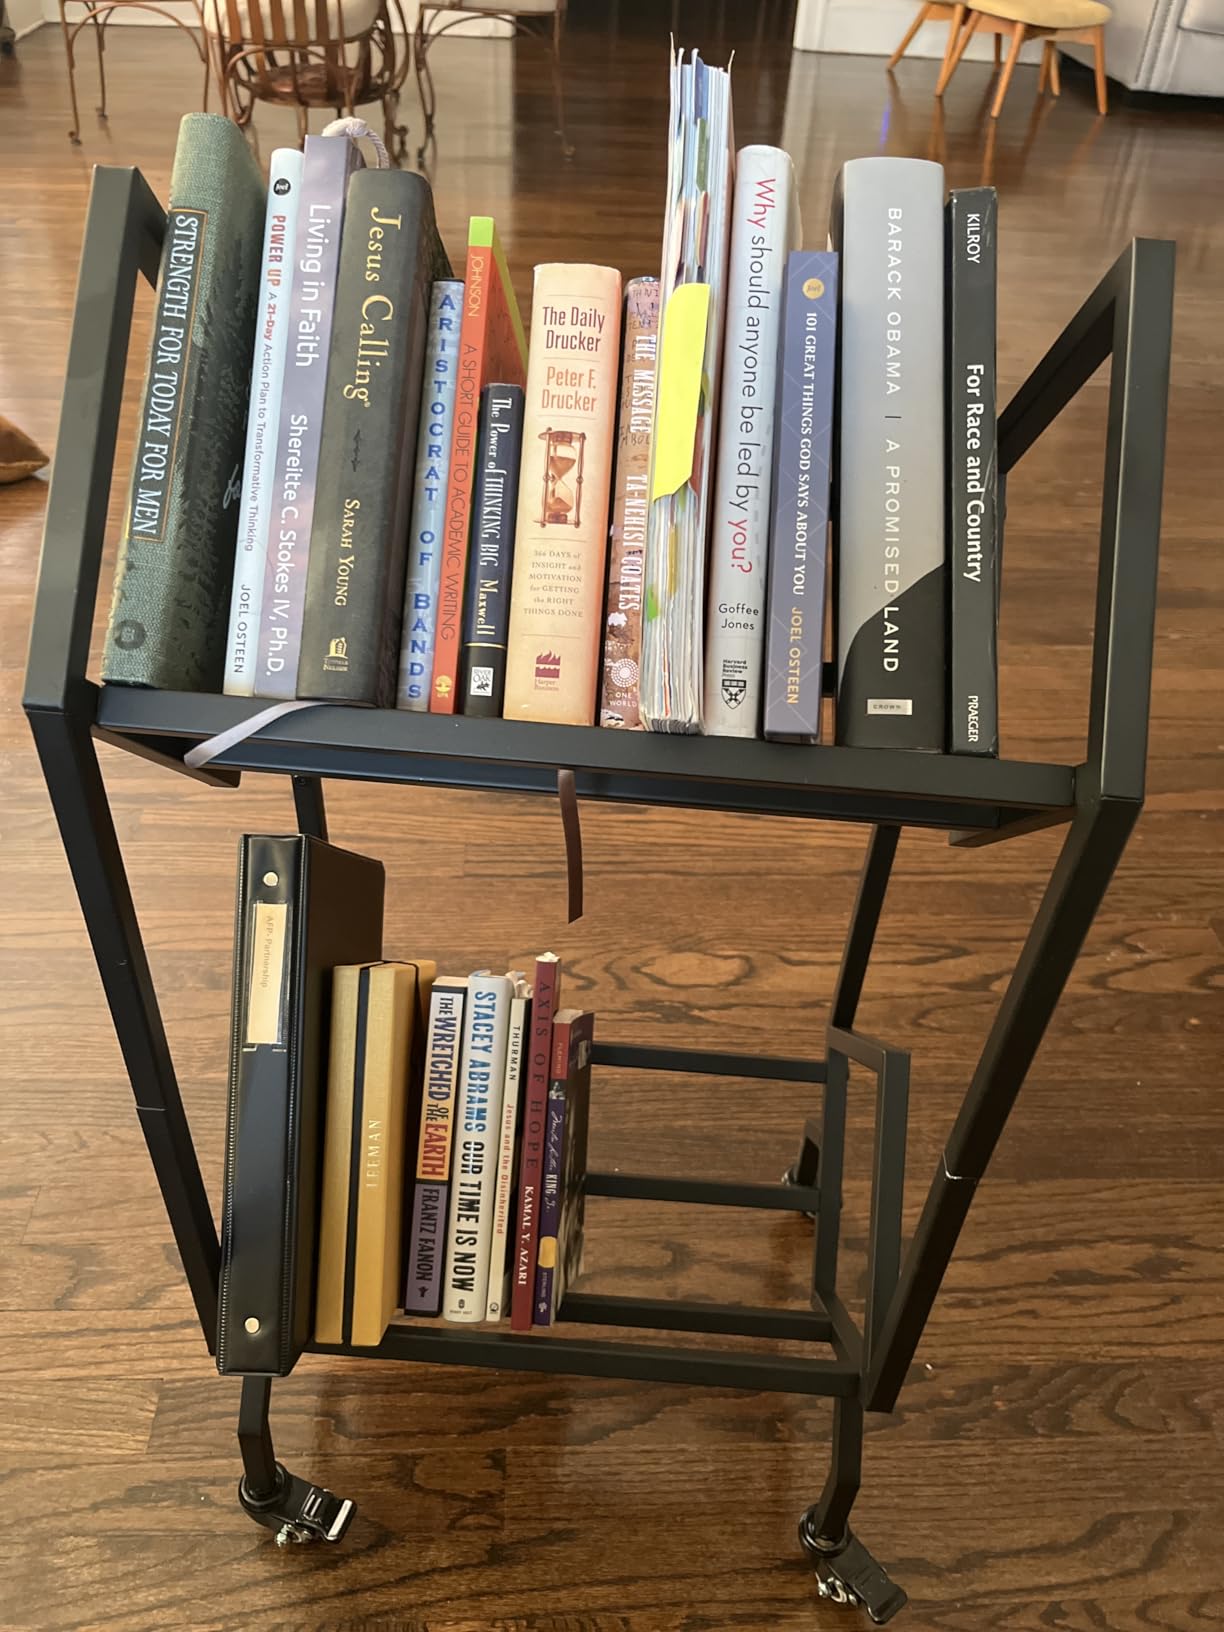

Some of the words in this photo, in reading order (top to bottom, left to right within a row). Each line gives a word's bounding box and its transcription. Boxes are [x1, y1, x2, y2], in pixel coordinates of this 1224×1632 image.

[747, 178, 776, 230] Why
[268, 215, 286, 263] POWER
[300, 204, 332, 273] Living
[365, 207, 402, 281] Jesus
[887, 208, 902, 301] BARACK
[966, 213, 981, 264] KILROY
[162, 214, 199, 320] STRENGTH
[267, 269, 282, 286] UP
[468, 254, 485, 317] JOHNSON
[747, 235, 773, 309] should
[268, 292, 277, 301] A
[301, 281, 326, 301] in
[264, 304, 277, 341] 21-Day
[296, 308, 321, 367] Faith
[543, 306, 565, 326] The
[570, 308, 605, 334] Daily
[545, 329, 601, 352] Drucker
[805, 312, 817, 332] 101
[156, 326, 184, 364] FOR
[261, 344, 274, 378] Action
[464, 344, 477, 354] A
[635, 334, 657, 361] THE
[738, 316, 763, 397] anyone
[803, 335, 816, 380] GREAT
[886, 312, 902, 395] OBAMA
[259, 382, 271, 404] Plan
[424, 294, 456, 501] ARISTOCRAT
[460, 360, 477, 408] SHORT
[547, 366, 585, 388] Peter
[588, 368, 597, 389] F.
[966, 364, 984, 396] For
[146, 372, 179, 444] TODAY
[257, 408, 267, 419] to
[491, 397, 512, 417] The
[541, 389, 597, 412] Drucker
[630, 369, 655, 433] MESSAGE
[739, 406, 764, 434] be
[801, 383, 815, 435] THINGS
[455, 412, 472, 457] GUIDE
[488, 423, 510, 457] Power
[886, 439, 900, 453] A
[966, 403, 984, 449] Race
[138, 443, 168, 482] FOR
[250, 422, 266, 502] Transformative
[282, 414, 308, 501] Shereitte
[453, 461, 468, 482] TO
[487, 461, 507, 475] of
[736, 442, 761, 476] led
[799, 438, 811, 471] GOD
[966, 456, 984, 493] and
[133, 489, 160, 534] MEN
[481, 476, 504, 539] THINKING
[623, 474, 648, 547] TA-NEHISI
[729, 485, 759, 512] by
[797, 474, 811, 508] SAYS
[244, 505, 259, 552] Thinking
[279, 507, 298, 525] C.
[340, 498, 360, 548] SARAH
[446, 488, 466, 568] ACADEMIC
[793, 511, 808, 561] ABOUT
[884, 465, 899, 593] PROMISED
[275, 529, 296, 593] Stokes
[419, 530, 435, 566] OF
[480, 543, 499, 567] BIG
[727, 519, 752, 573] you?
[964, 500, 984, 582] Country
[334, 555, 355, 606] YOUNG
[529, 573, 582, 582] MOTIVATION
[542, 585, 580, 594] GETTING
[619, 555, 643, 611] COATES
[792, 565, 805, 595] YOU
[238, 584, 251, 617] JOEL
[269, 599, 290, 620] IV,
[441, 573, 458, 640] WRITING
[476, 579, 499, 636] Maxwell
[523, 607, 556, 616] THINGS
[558, 608, 584, 617] DONE
[546, 597, 574, 605] RIGHT
[718, 602, 760, 616] Goffee
[408, 594, 431, 698] BANDS
[720, 618, 755, 630] Jones
[790, 607, 803, 643] JOEL
[883, 606, 899, 672] LAND
[234, 622, 247, 673] OSTEEN
[266, 627, 289, 677] Ph.D.
[787, 648, 800, 704] OSTEEN
[609, 699, 637, 707] WORLD
[967, 695, 979, 742] PRAEGER
[259, 938, 273, 987] Partnership
[438, 997, 454, 1015] THE
[471, 991, 496, 1054] STACEY
[535, 982, 551, 1037] AXIS
[428, 1016, 457, 1101] WRETCHED
[508, 1026, 521, 1081] THURMAN
[533, 1053, 546, 1084] OF
[426, 1103, 438, 1122] THE
[438, 1107, 449, 1120] OF
[463, 1058, 491, 1132] ABRAMS
[505, 1104, 514, 1130] Jesus
[421, 1123, 448, 1176] EARTH
[503, 1133, 511, 1151] and
[526, 1101, 542, 1168] HOPE
[460, 1141, 485, 1175] OUR
[501, 1155, 510, 1170] the
[419, 1187, 440, 1233] FRANTZ
[456, 1181, 482, 1224] TIME
[496, 1174, 508, 1234] Disinherited
[522, 1185, 535, 1230] KAMAL
[415, 1237, 436, 1282] FANON
[455, 1229, 478, 1246] IS
[520, 1232, 531, 1244] Y.
[452, 1251, 476, 1292] NOW
[518, 1247, 529, 1285] AZARI
